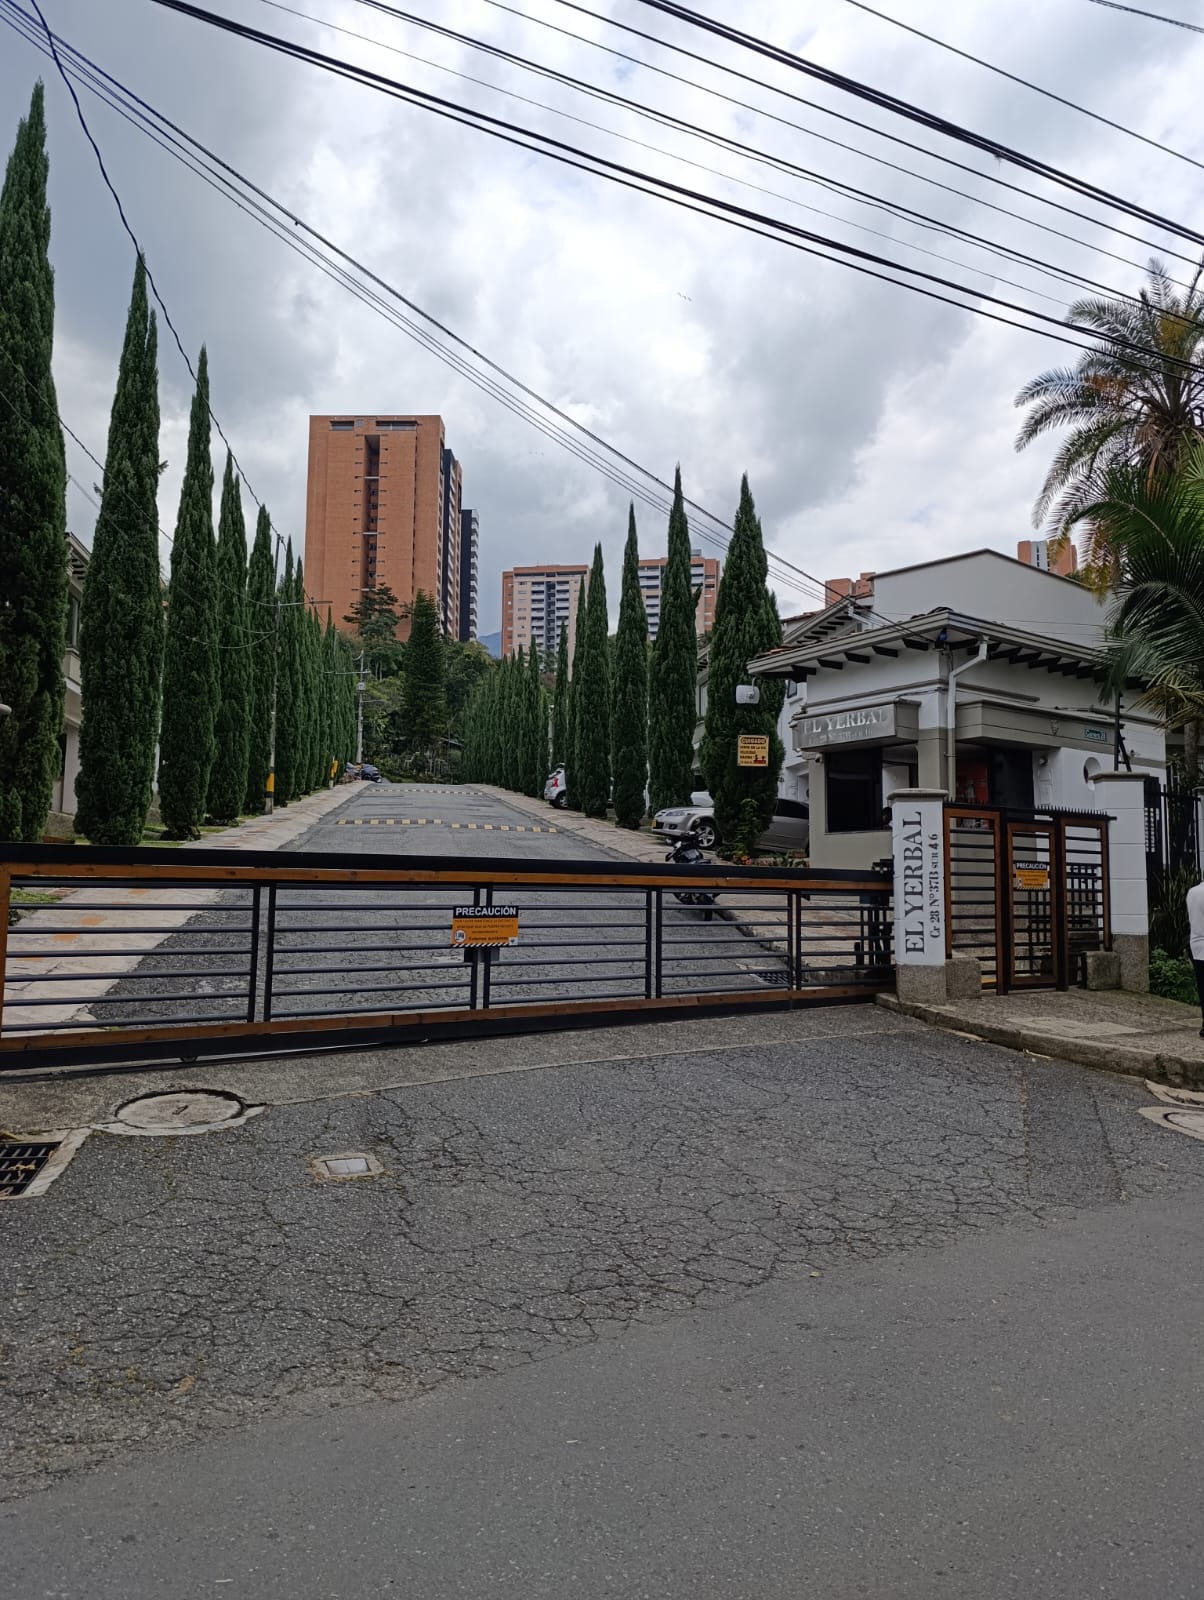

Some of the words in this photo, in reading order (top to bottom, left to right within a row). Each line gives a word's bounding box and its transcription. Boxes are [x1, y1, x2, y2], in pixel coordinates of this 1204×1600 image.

[825, 708, 889, 730] YERBAL
[902, 811, 924, 918] YERBAL
[455, 905, 516, 916] PRECAUCIÓN
[929, 910, 940, 924] 28
[904, 920, 925, 955] EL
[929, 924, 941, 939] Cr
